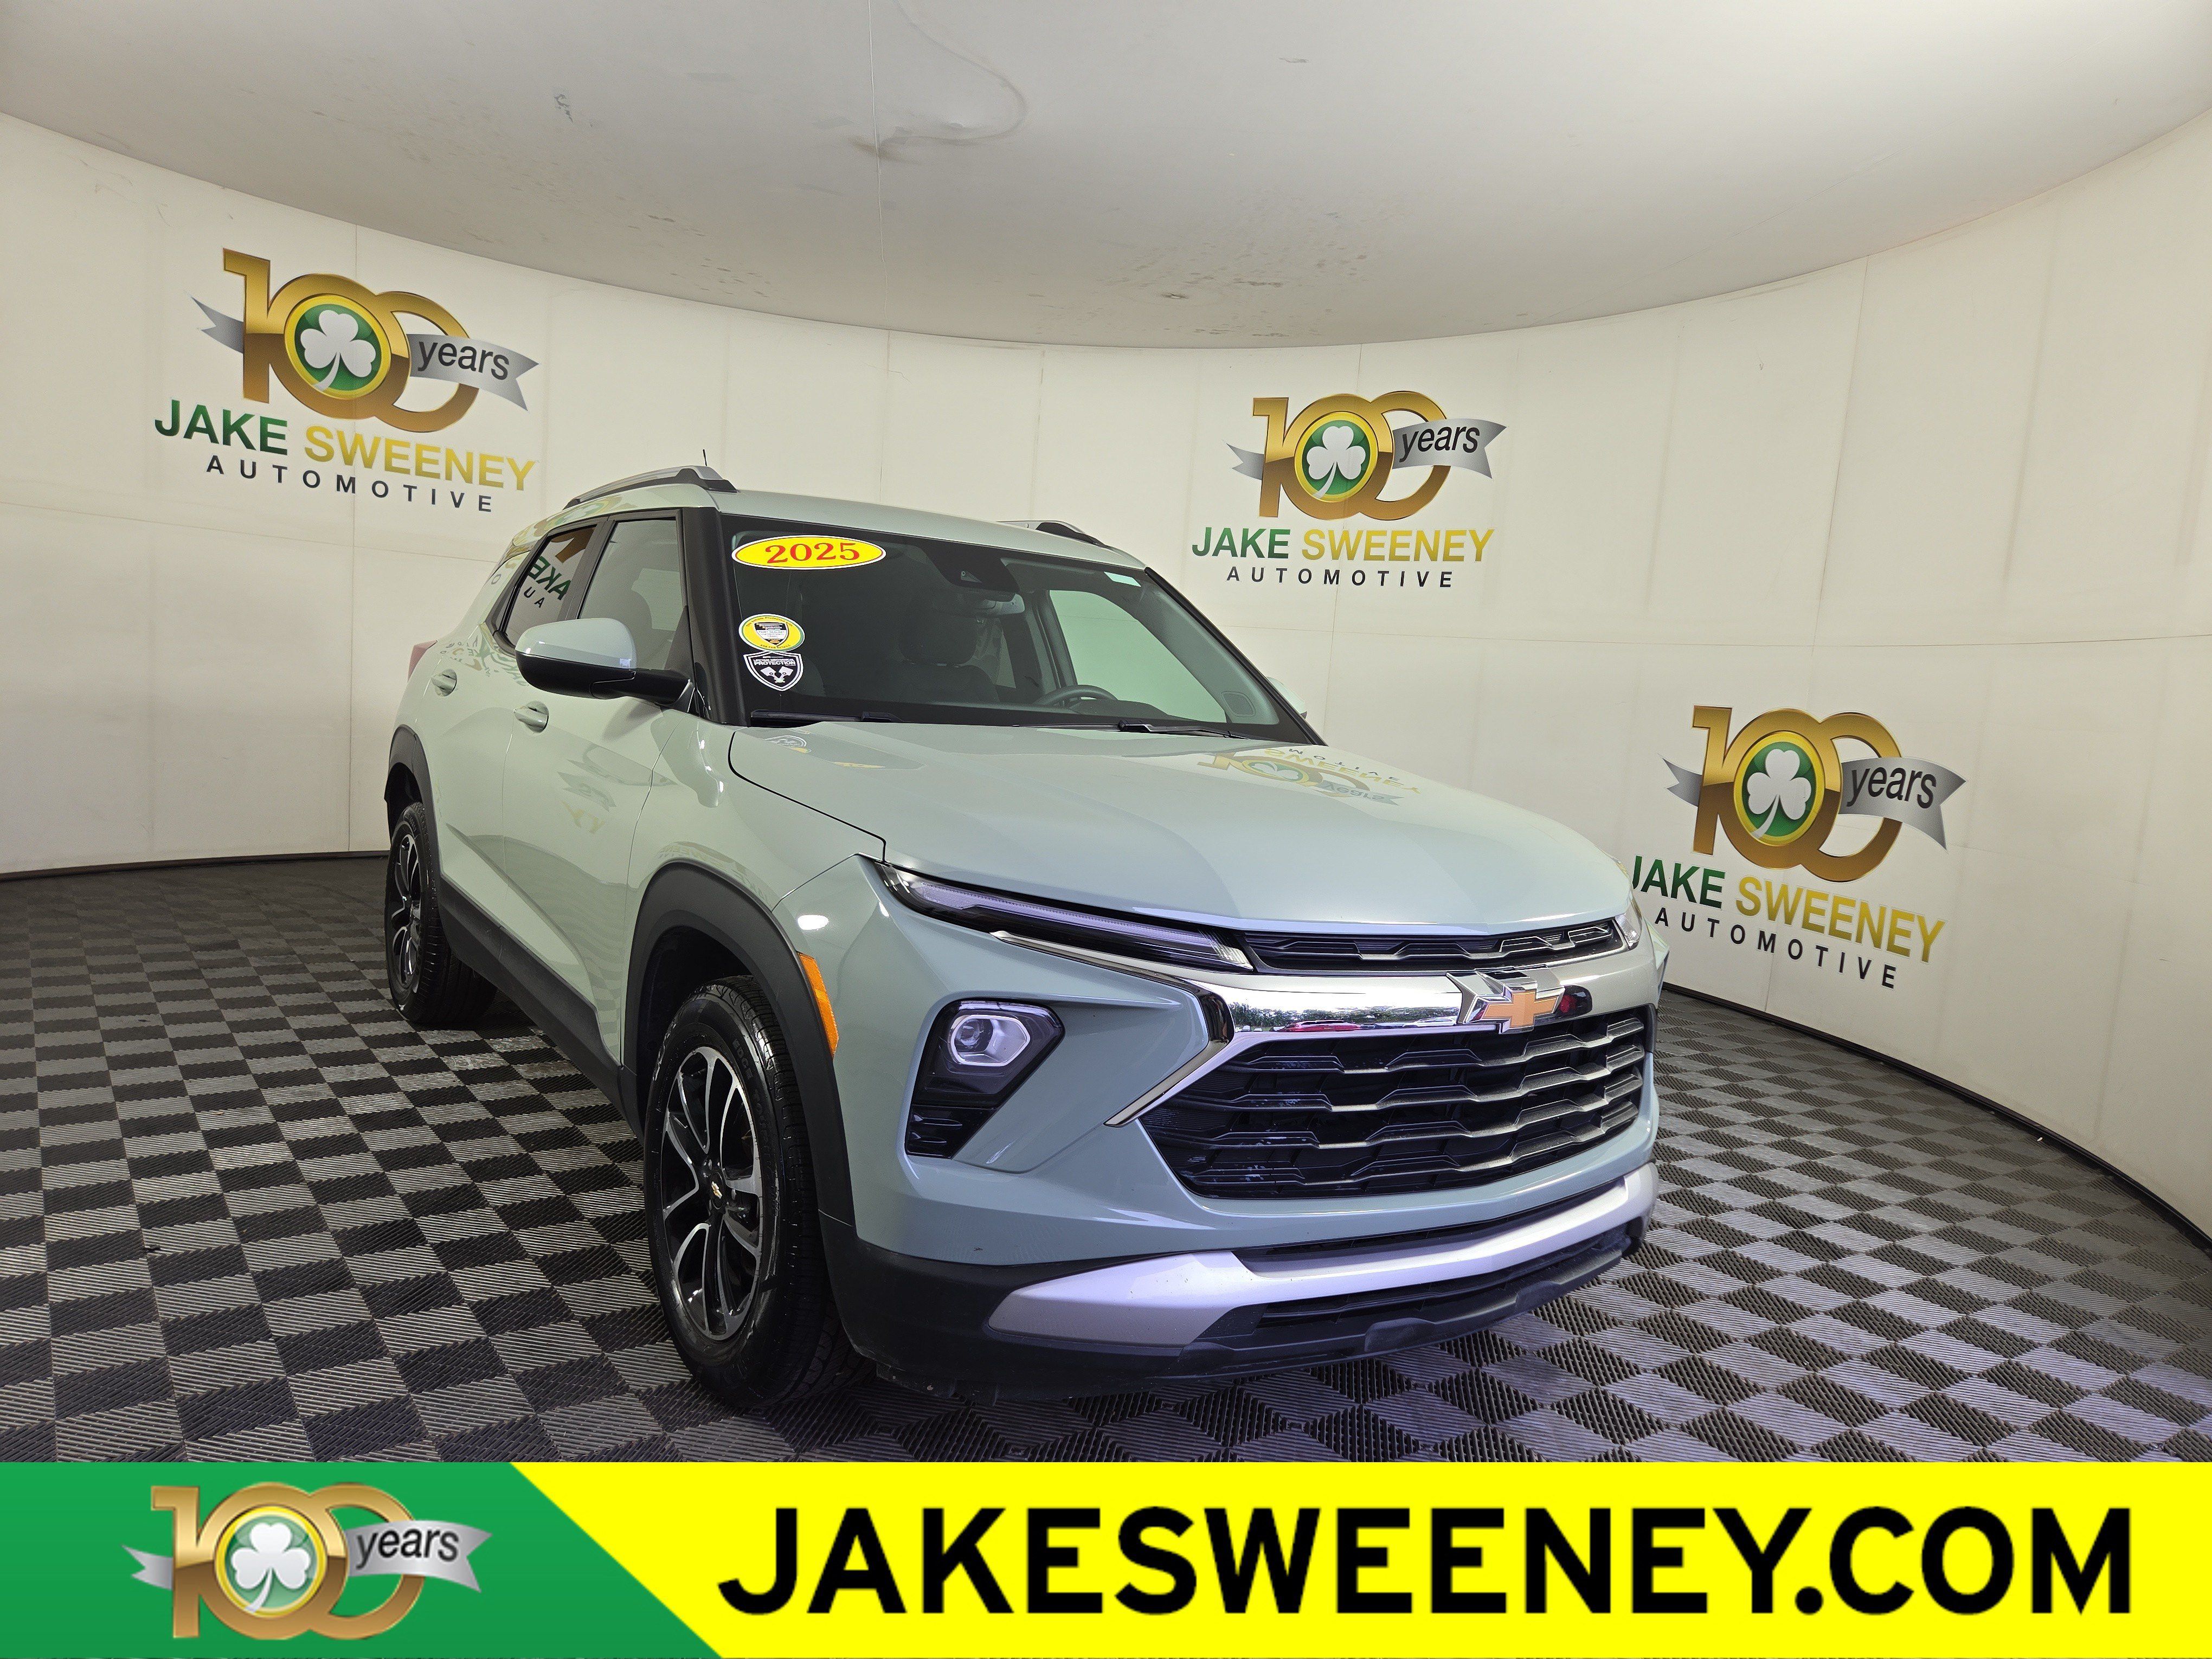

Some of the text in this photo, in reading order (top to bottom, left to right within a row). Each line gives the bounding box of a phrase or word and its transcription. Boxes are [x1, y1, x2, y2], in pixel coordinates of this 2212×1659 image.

[222, 248, 510, 433] 100 years
[155, 399, 536, 491] JAKE SWEENEY
[206, 455, 492, 512] AUTOMOTIVE
[1252, 390, 1480, 520] 100 years
[765, 543, 860, 563] 2025
[1192, 527, 1495, 562] JAKE SWEENEY
[1226, 566, 1452, 588] AUTOMOTIVE
[1692, 705, 1937, 882] 100 years
[1632, 855, 1946, 962] JAKE SWEENEY
[1654, 907, 1896, 989] AUTOMOTIVE
[732, 1039, 753, 1080] EDGE
